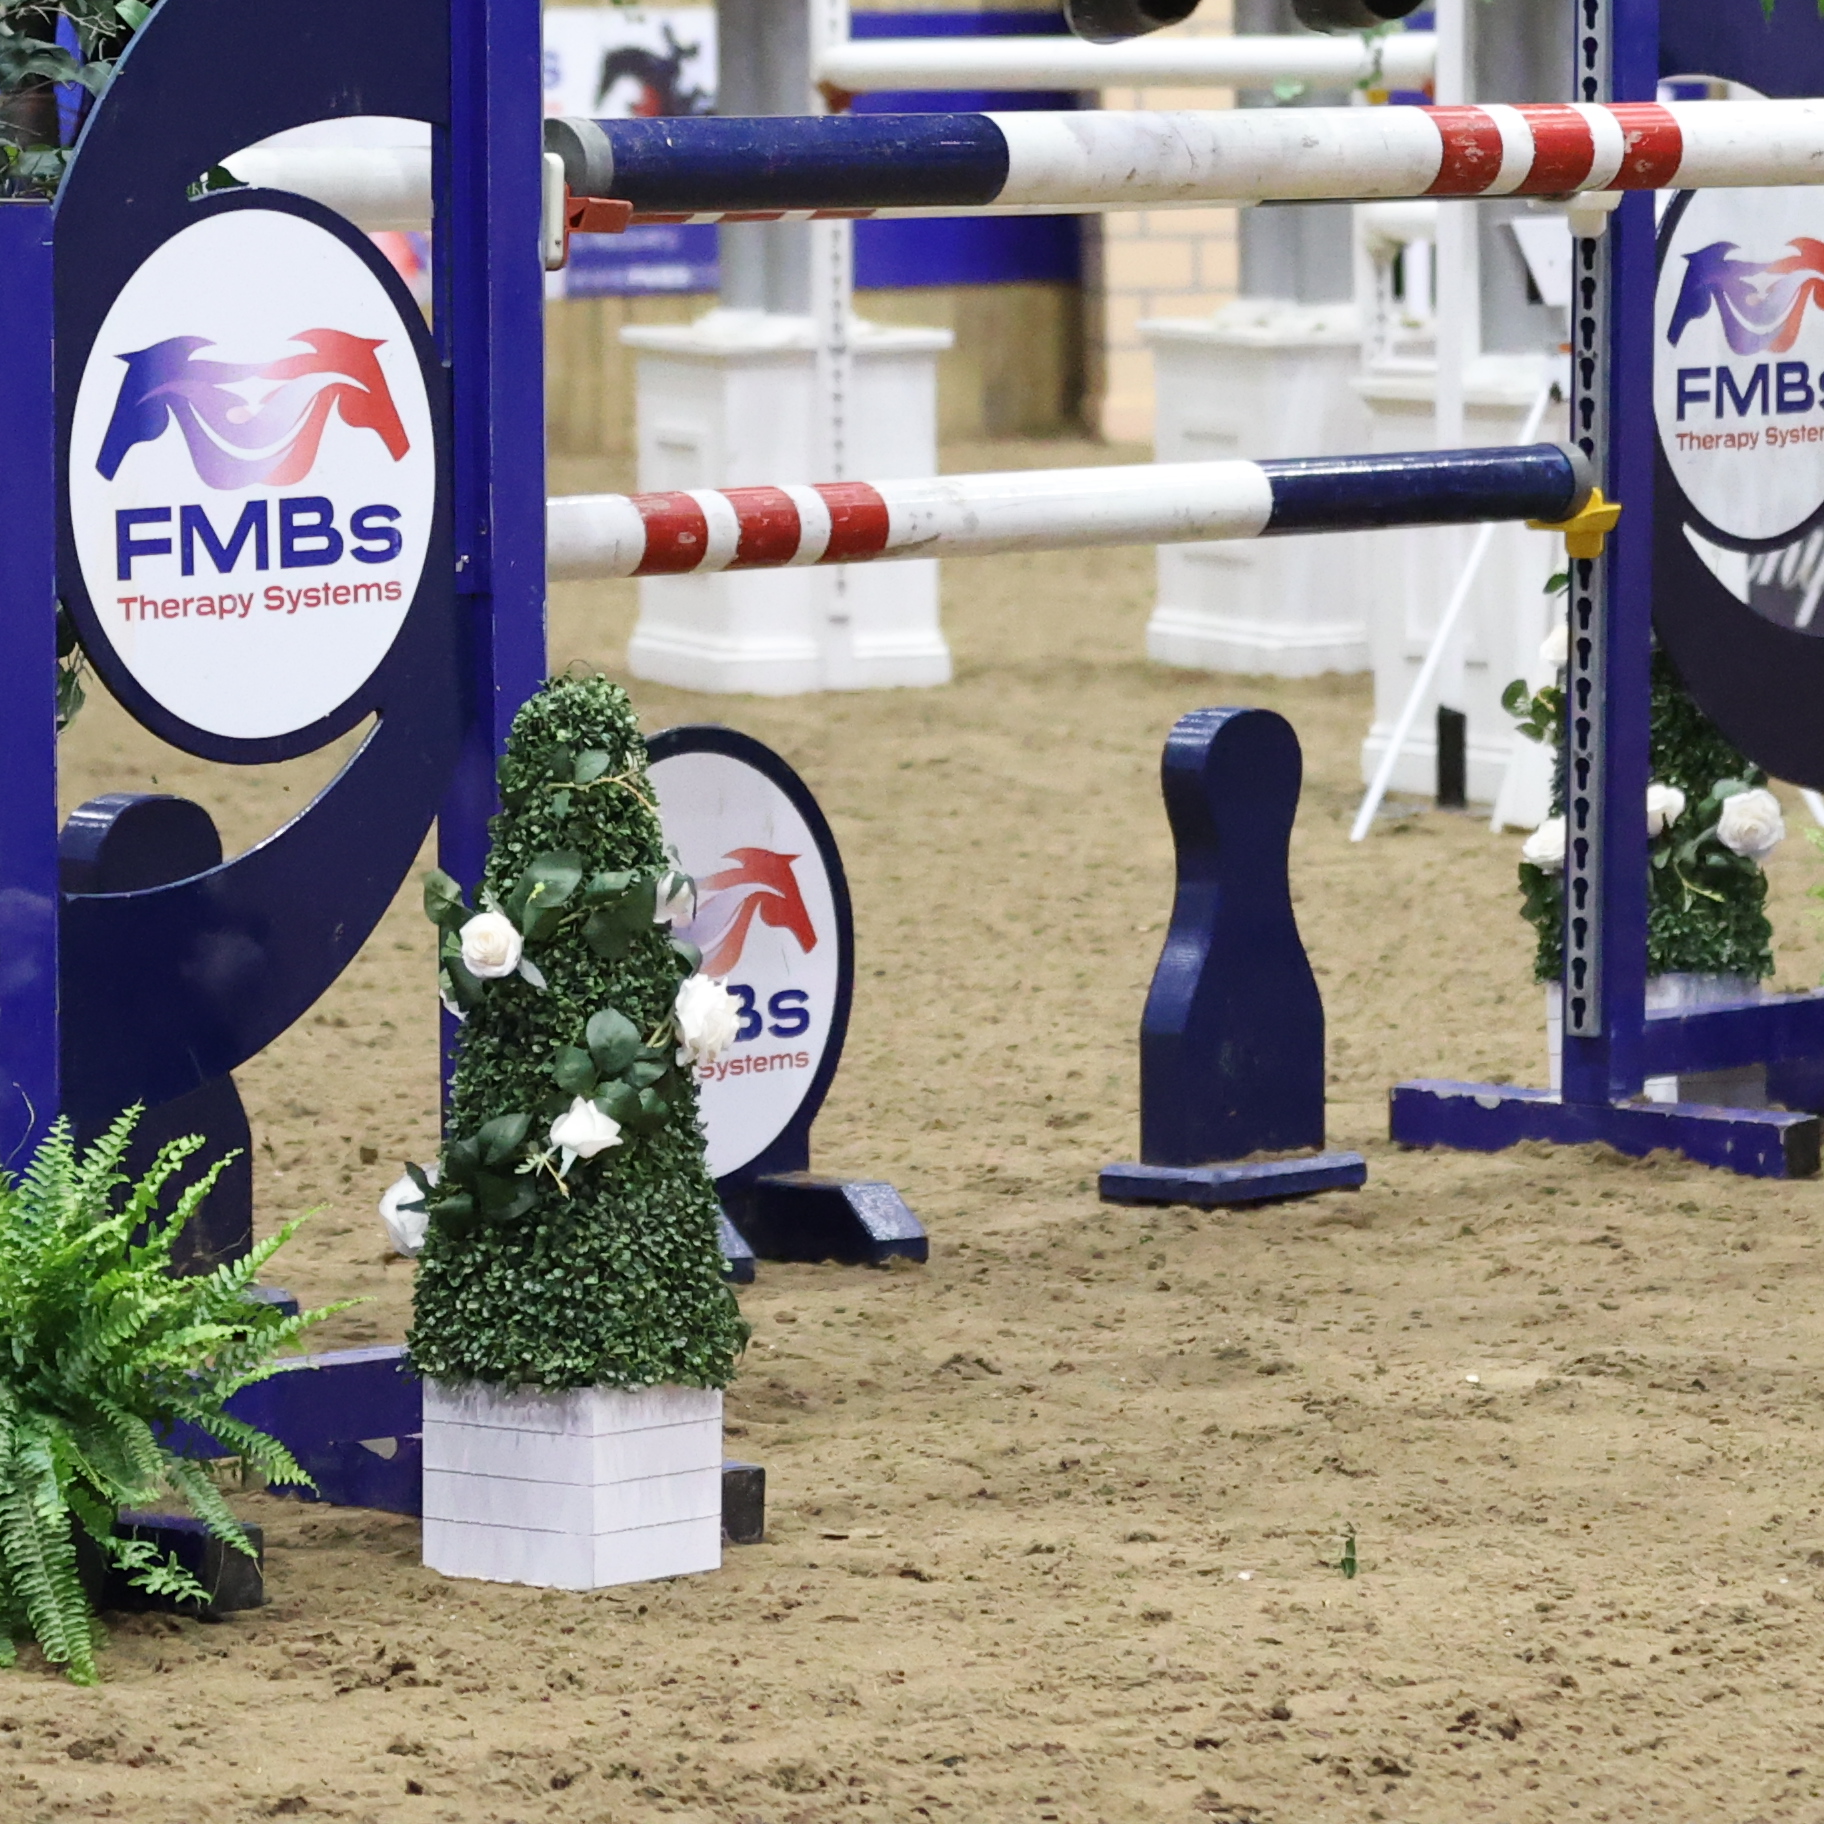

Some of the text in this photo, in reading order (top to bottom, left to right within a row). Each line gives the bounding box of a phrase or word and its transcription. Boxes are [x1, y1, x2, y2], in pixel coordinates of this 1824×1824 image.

[1677, 431, 1758, 452] Therapy
[114, 496, 404, 581] FMBs
[117, 580, 403, 622] Therapy Systems
[725, 983, 810, 1043] Bs
